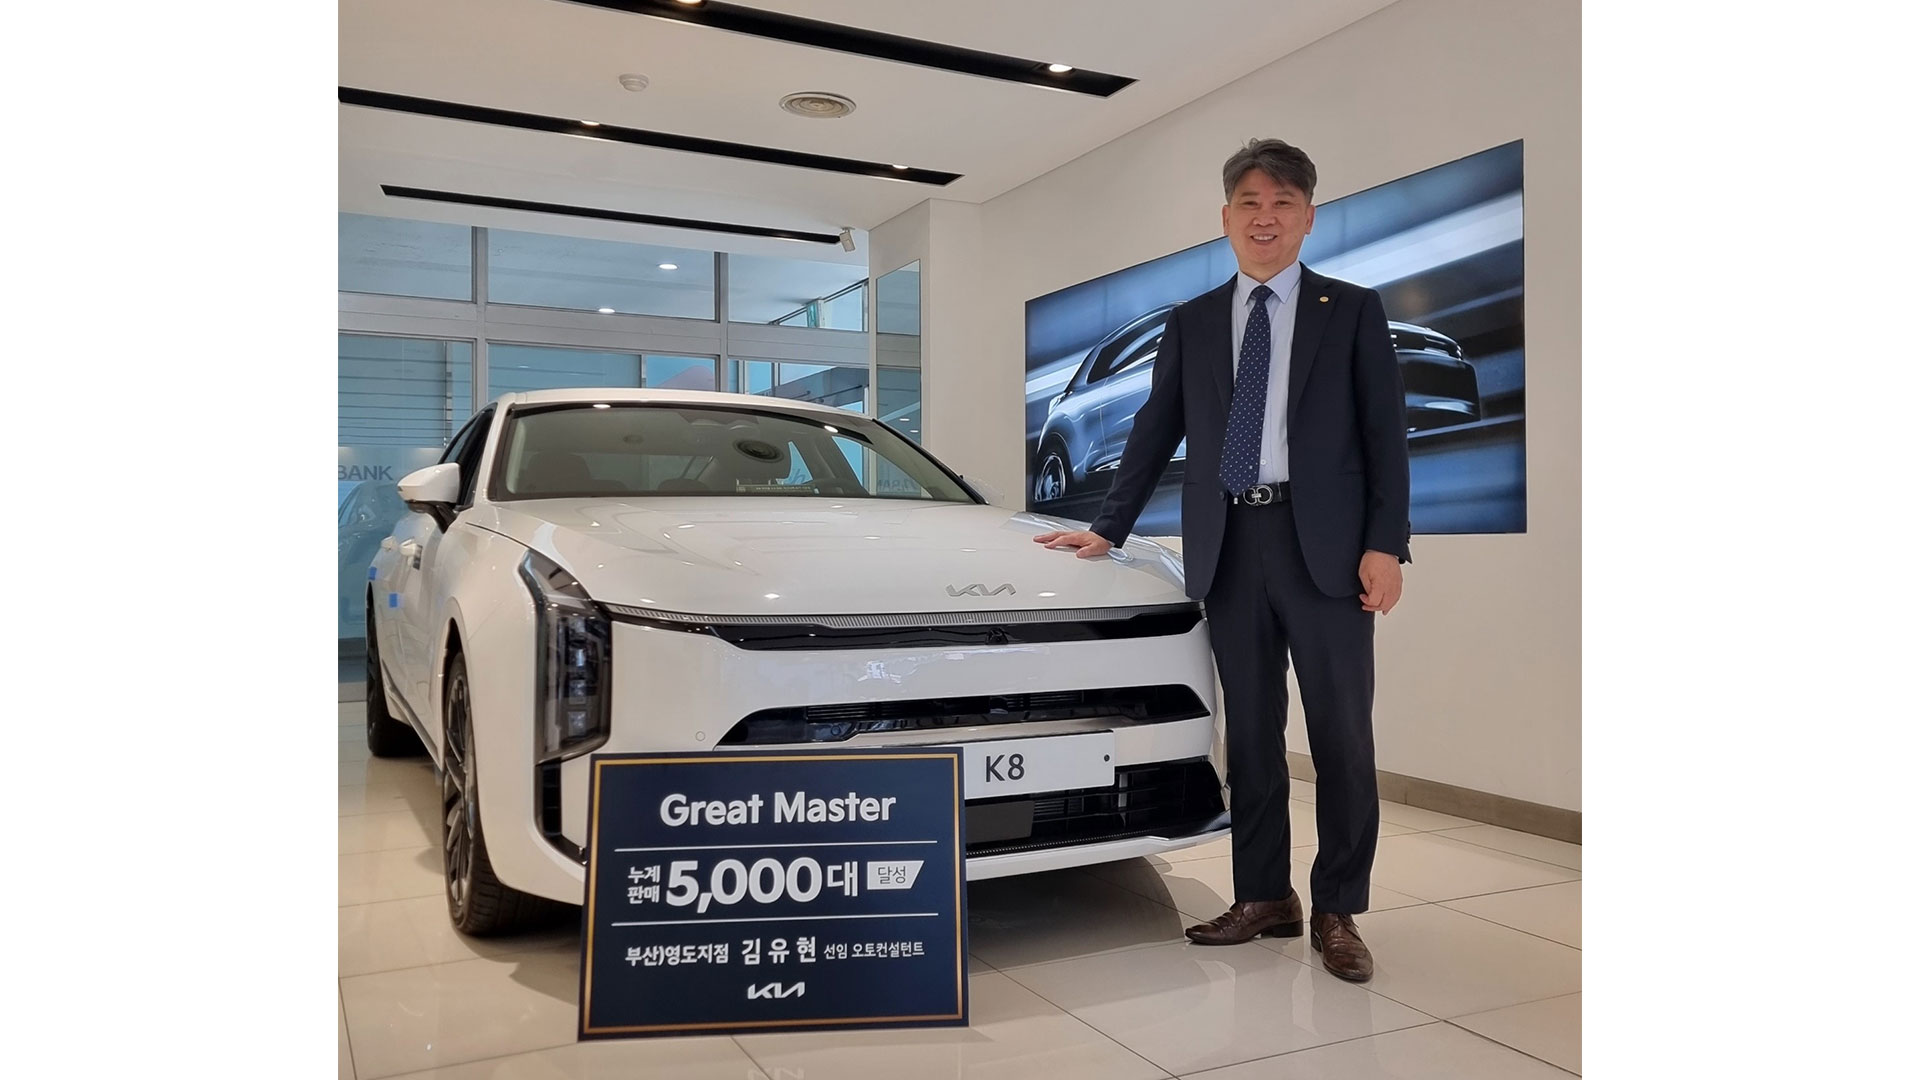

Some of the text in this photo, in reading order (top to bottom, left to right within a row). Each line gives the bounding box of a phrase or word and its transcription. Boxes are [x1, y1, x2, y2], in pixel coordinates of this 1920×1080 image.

[338, 464, 394, 481] BANK
[985, 753, 1026, 783] K8
[660, 791, 896, 826] Great Master
[628, 865, 660, 884] 누계
[877, 865, 906, 885] 달성
[627, 885, 660, 904] 판매
[625, 943, 729, 967] 부산)영도지점
[824, 943, 848, 960] 선임
[852, 942, 925, 958] 오토컨설턴트
